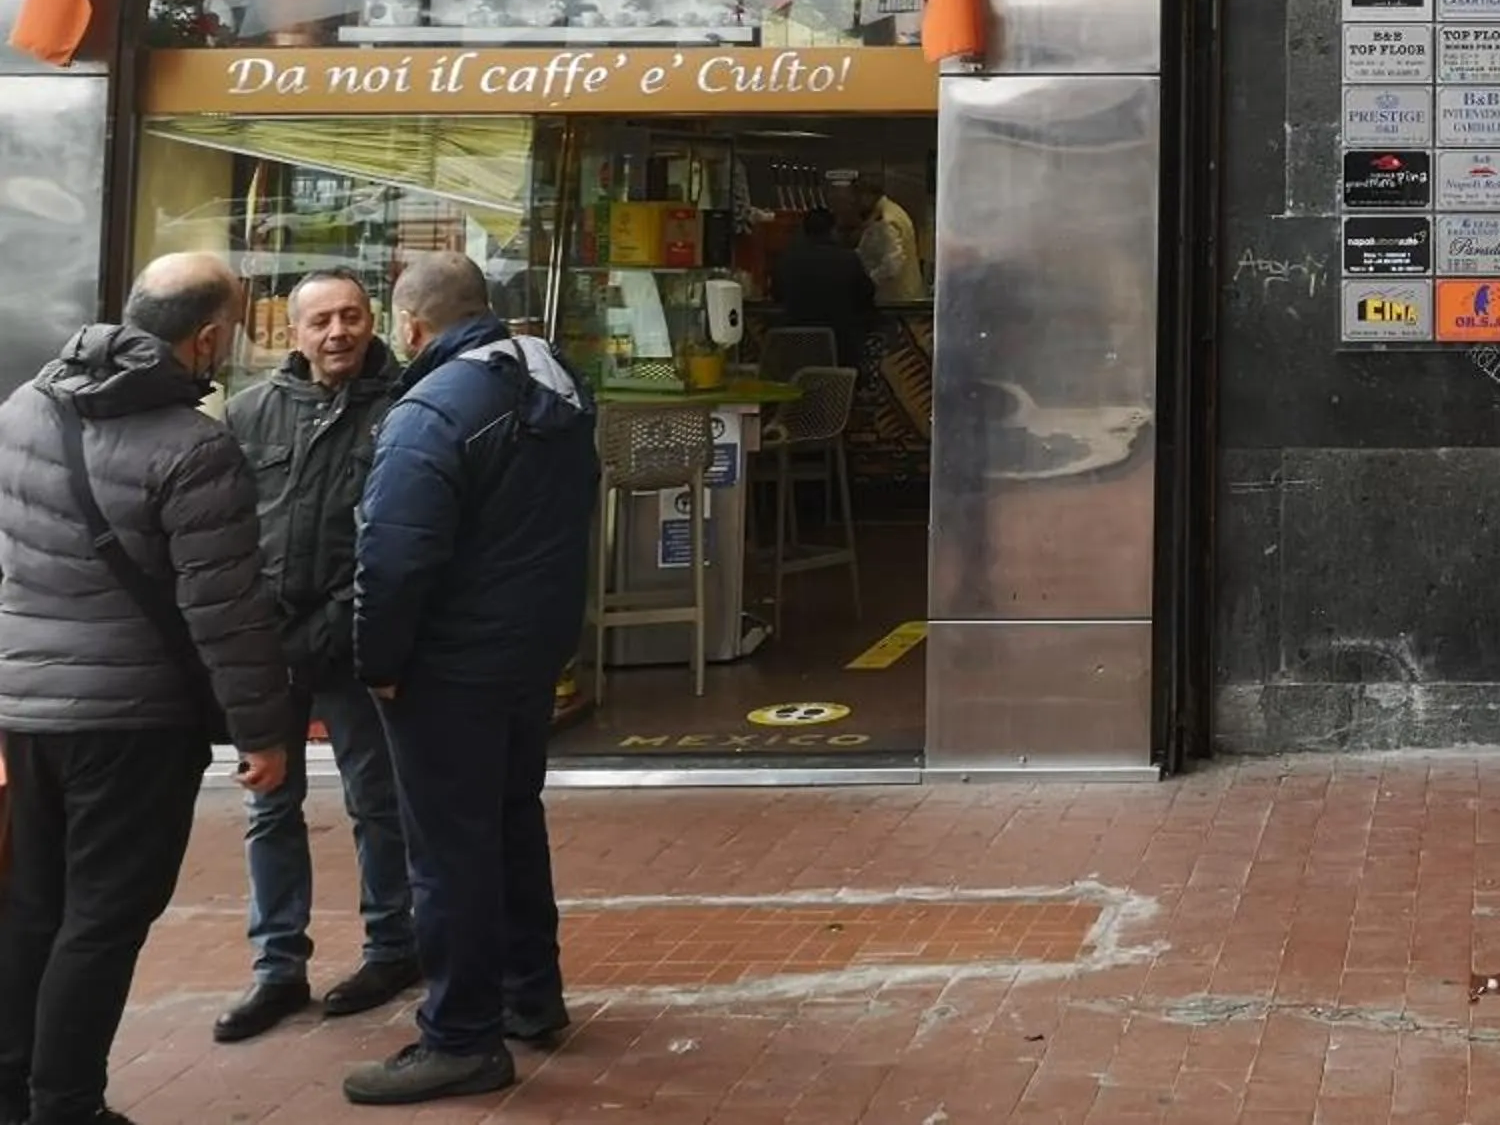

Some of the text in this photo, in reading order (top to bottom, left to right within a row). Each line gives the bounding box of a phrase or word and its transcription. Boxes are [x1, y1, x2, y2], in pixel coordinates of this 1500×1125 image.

[1443, 29, 1472, 41] TOP
[1349, 44, 1426, 56] TOP FLOOR
[226, 56, 309, 94] Da
[325, 55, 412, 94] noi
[430, 51, 479, 93] il
[479, 50, 629, 101] caffe'
[696, 51, 852, 93] Culto!
[1463, 92, 1500, 106] B&B
[1349, 110, 1425, 124] PRESTIGE
[618, 732, 872, 748] MEXICO
